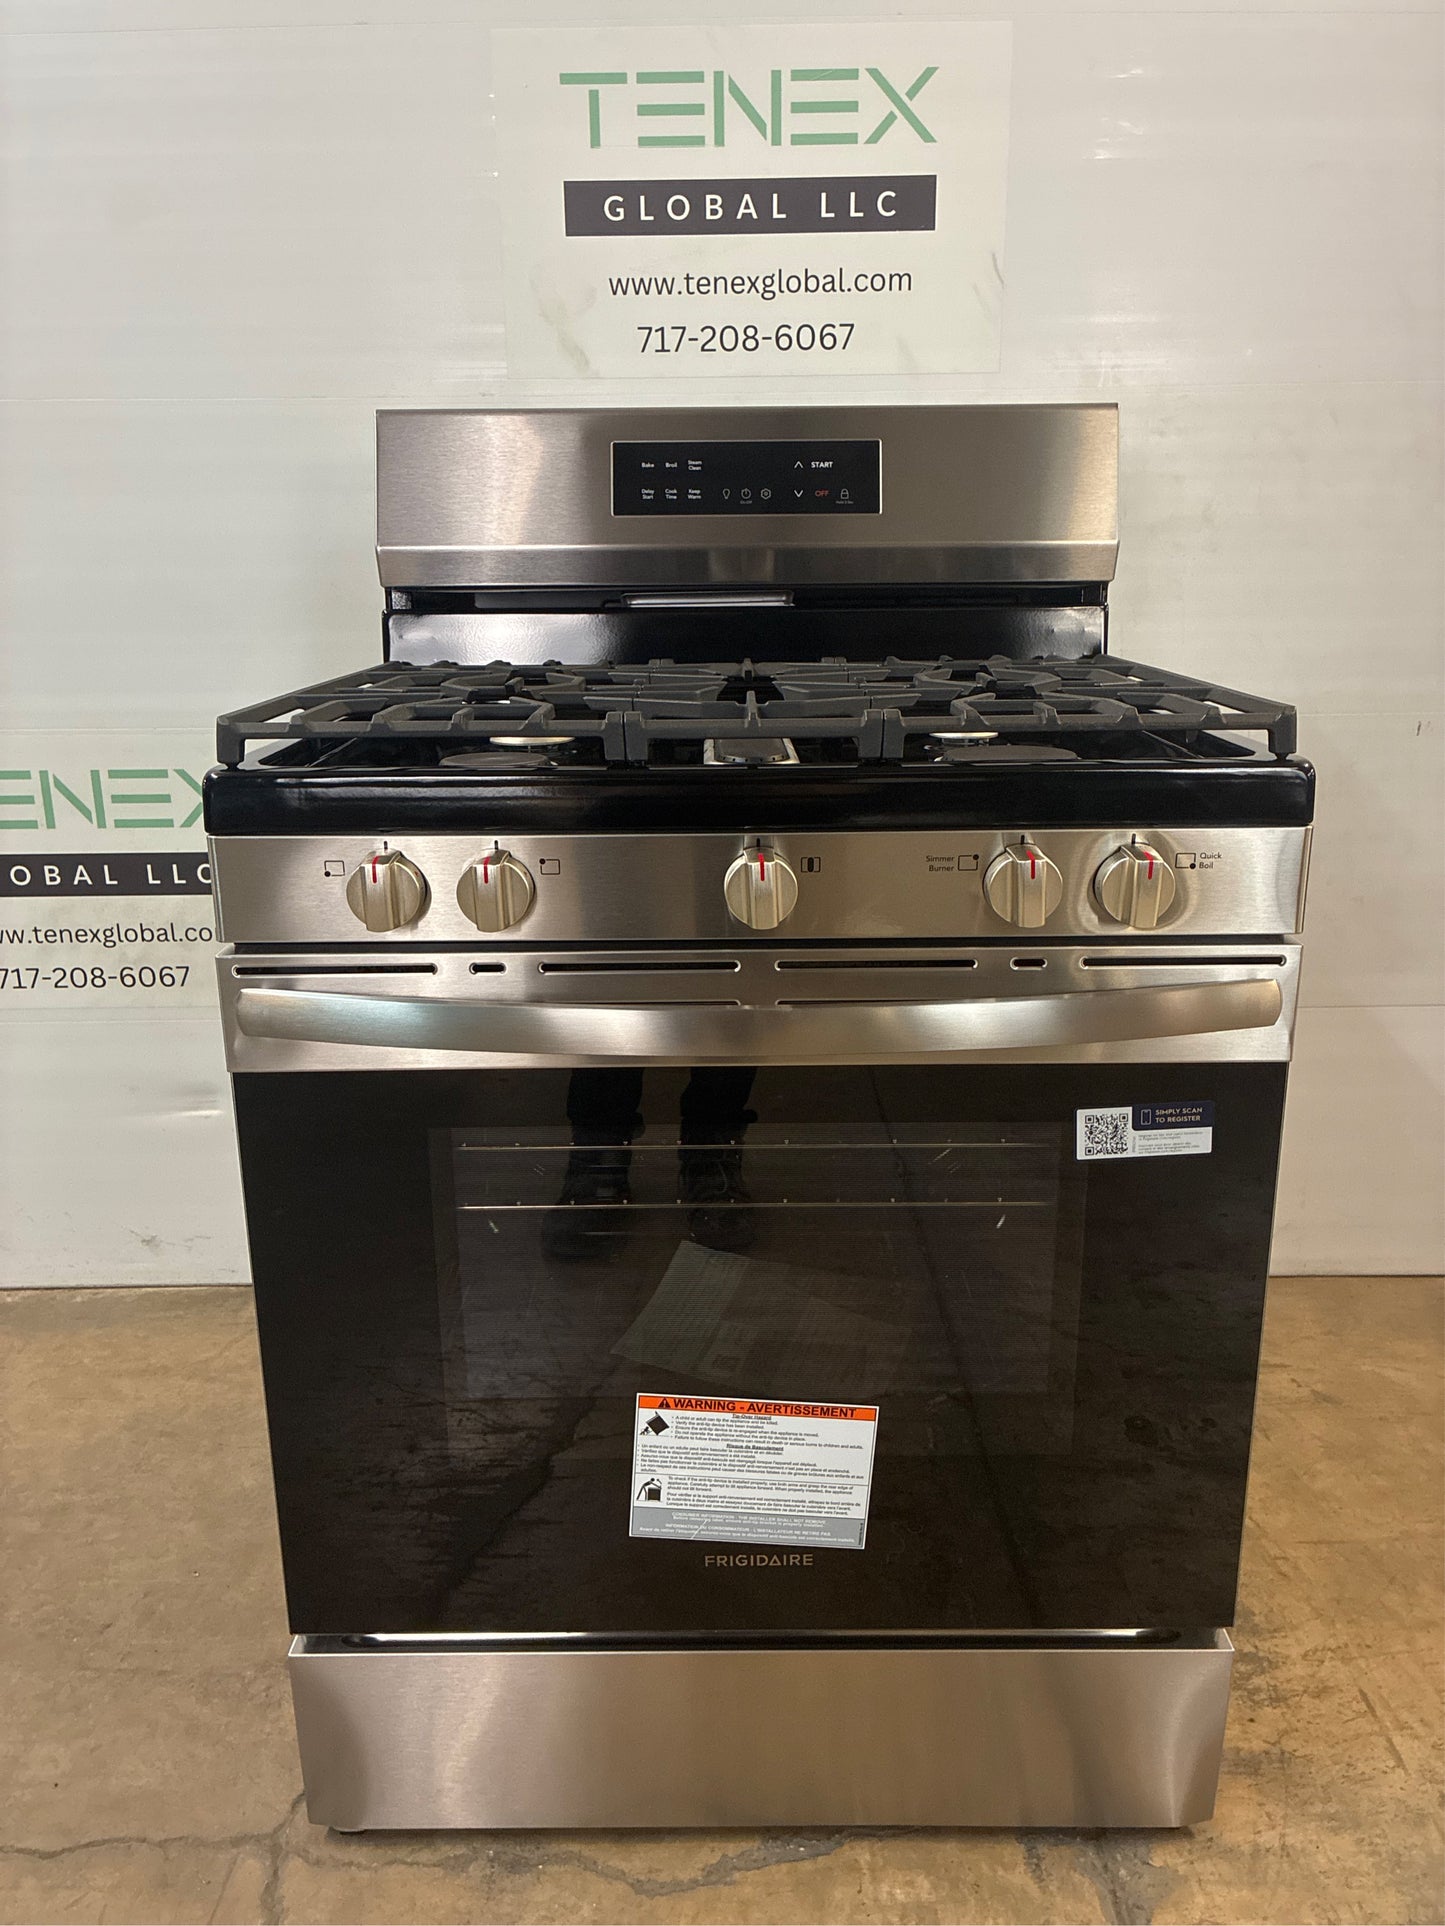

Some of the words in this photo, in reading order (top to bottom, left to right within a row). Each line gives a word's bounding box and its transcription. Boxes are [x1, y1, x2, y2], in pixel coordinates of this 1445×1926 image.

[559, 66, 939, 149] TENEX
[603, 192, 787, 222] GLOBAL
[820, 190, 898, 218] LLC
[608, 268, 913, 300] www.tenexglobal.com
[637, 323, 855, 353] 717-208-6067
[926, 855, 954, 863] Simmer
[1200, 852, 1222, 860] Quick
[146, 864, 212, 885] LLC
[0, 966, 190, 989] 717-208-6067
[674, 1399, 736, 1411] WARNING
[747, 1403, 856, 1417] AVERTISSEMENT
[704, 1554, 814, 1567] FRIGIDAIRE
